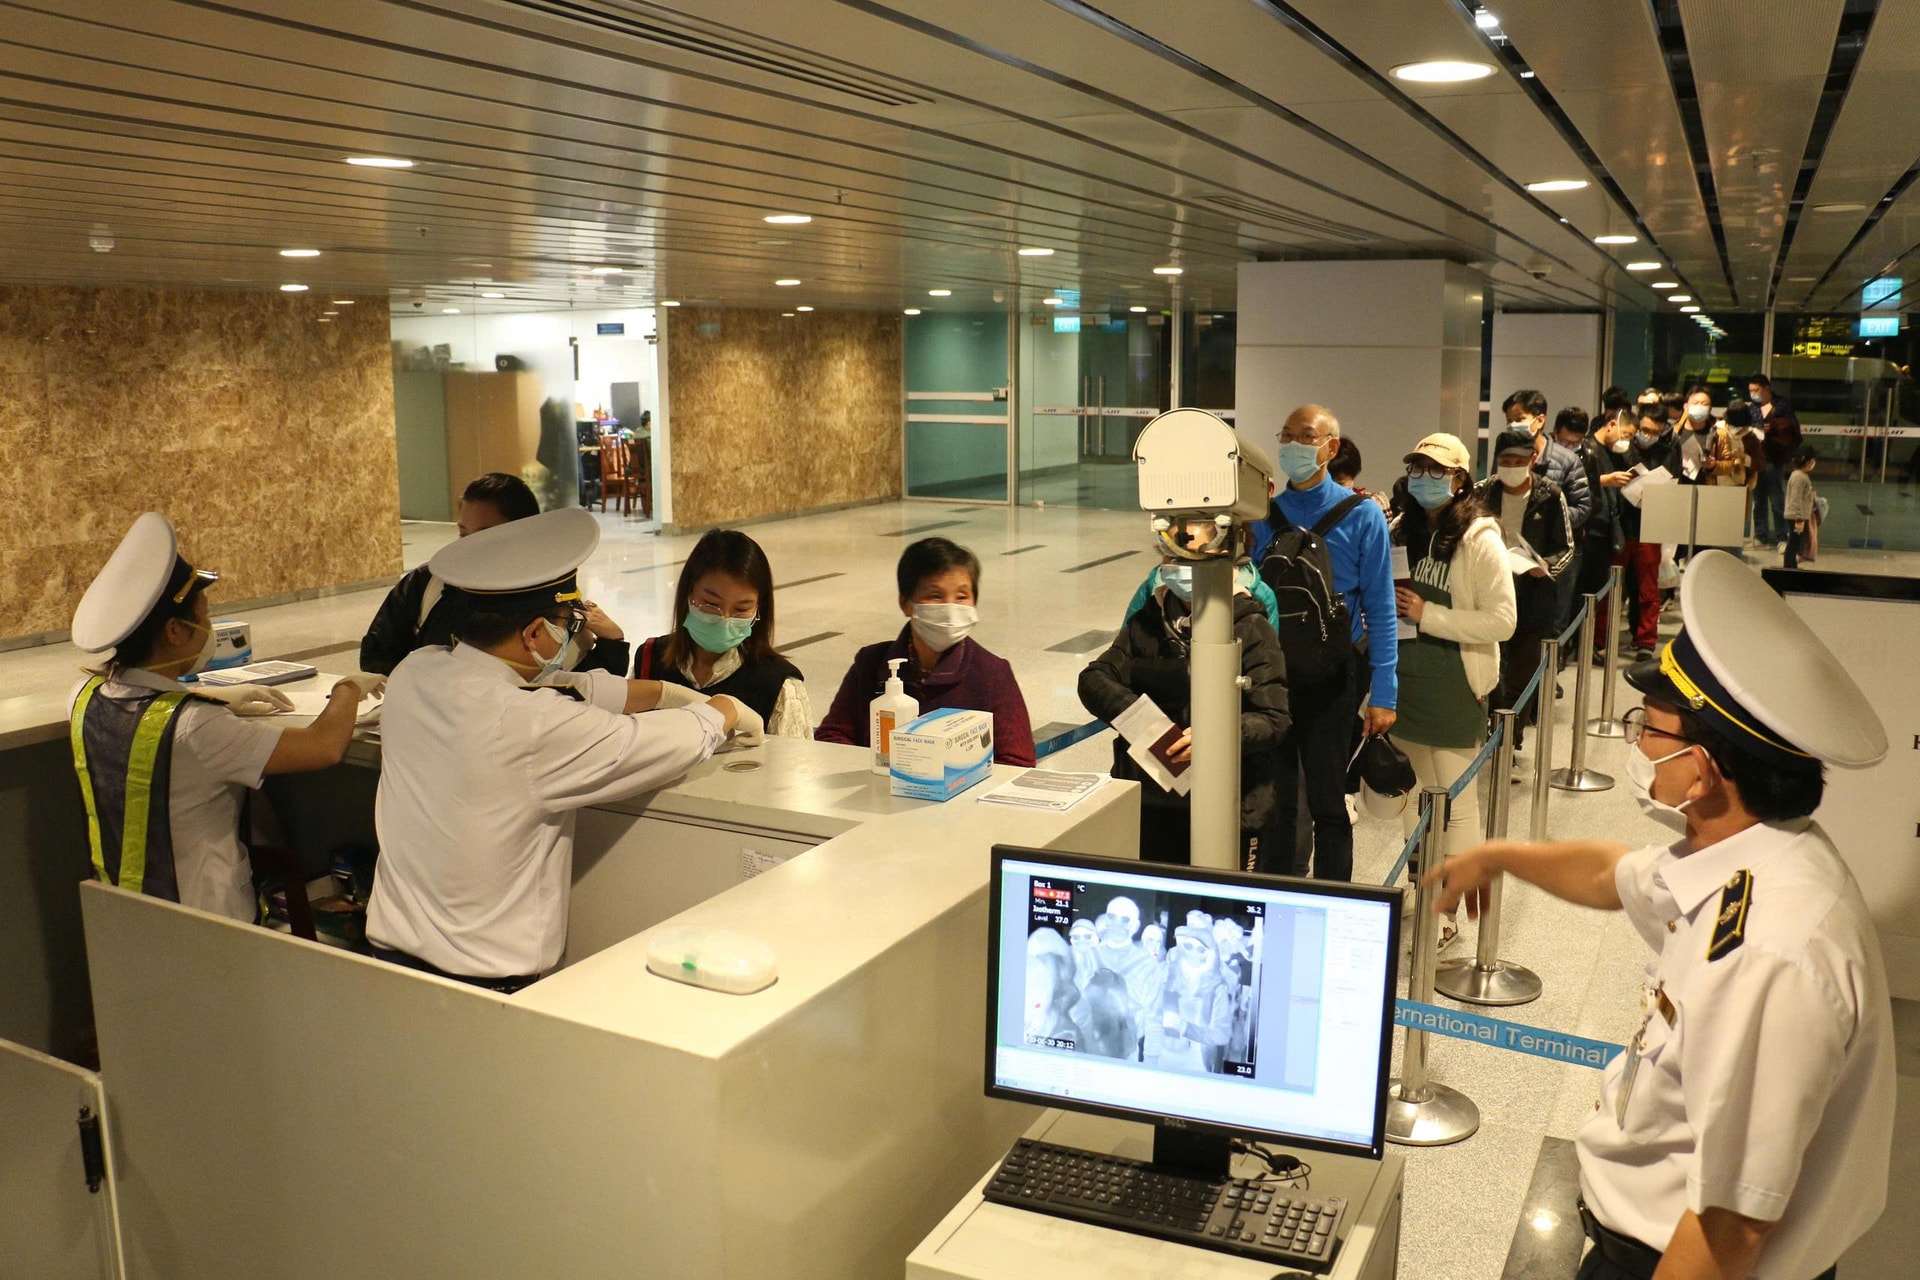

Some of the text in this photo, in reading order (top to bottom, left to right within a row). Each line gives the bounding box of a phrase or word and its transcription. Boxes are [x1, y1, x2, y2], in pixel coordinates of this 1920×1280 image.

[1867, 321, 1891, 333] EXIT
[1246, 837, 1258, 872] BLAN
[1505, 1027, 1608, 1065] Terminal
